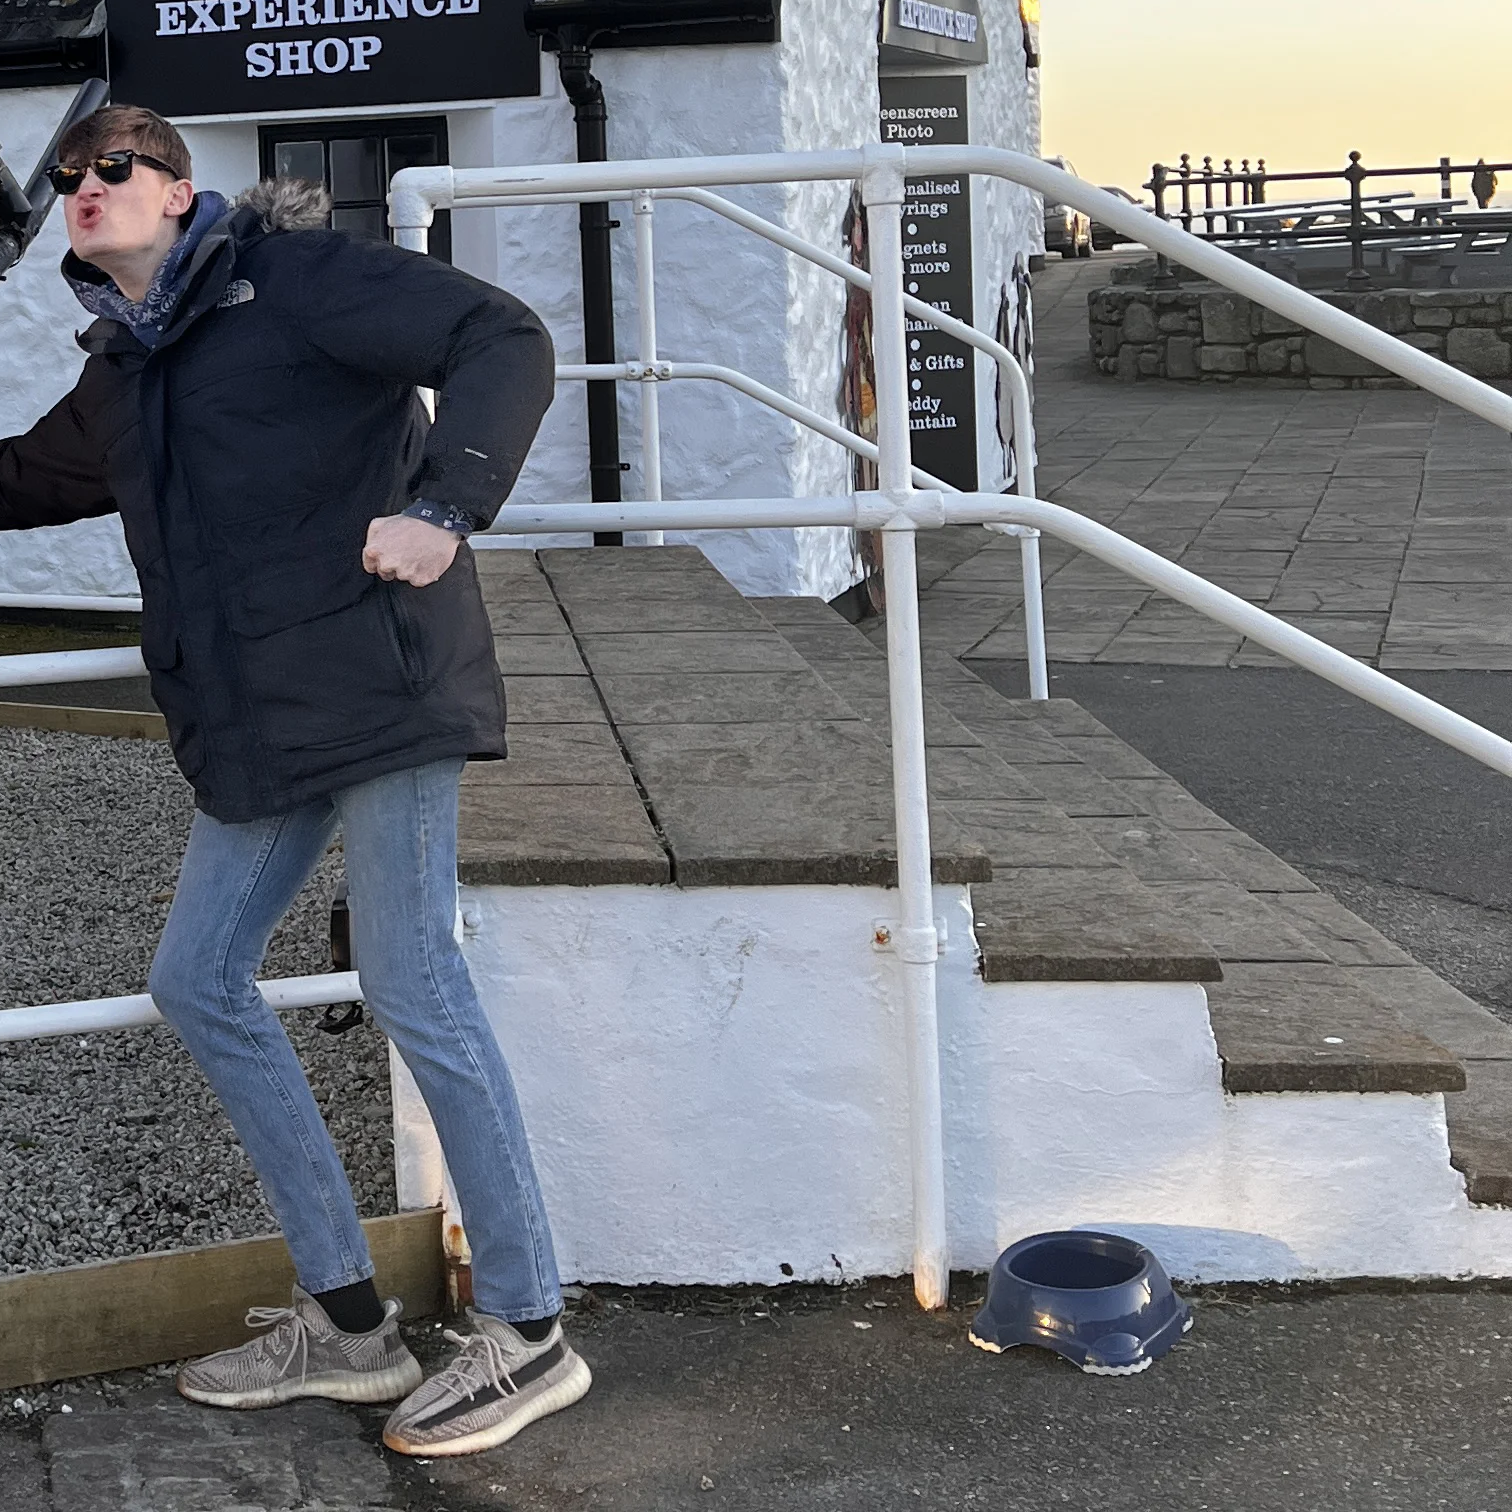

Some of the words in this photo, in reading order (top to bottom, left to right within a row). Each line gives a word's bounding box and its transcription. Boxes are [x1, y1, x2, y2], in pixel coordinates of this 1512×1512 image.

[955, 10, 977, 43] SHOP
[245, 35, 382, 78] SHOP
[879, 106, 959, 120] eenscreen
[886, 123, 934, 139] Photo
[905, 180, 961, 196] nalised
[899, 200, 949, 220] yrings
[902, 239, 948, 260] gnets
[909, 260, 951, 275] more
[909, 357, 922, 372] &
[925, 355, 965, 371] Gifts
